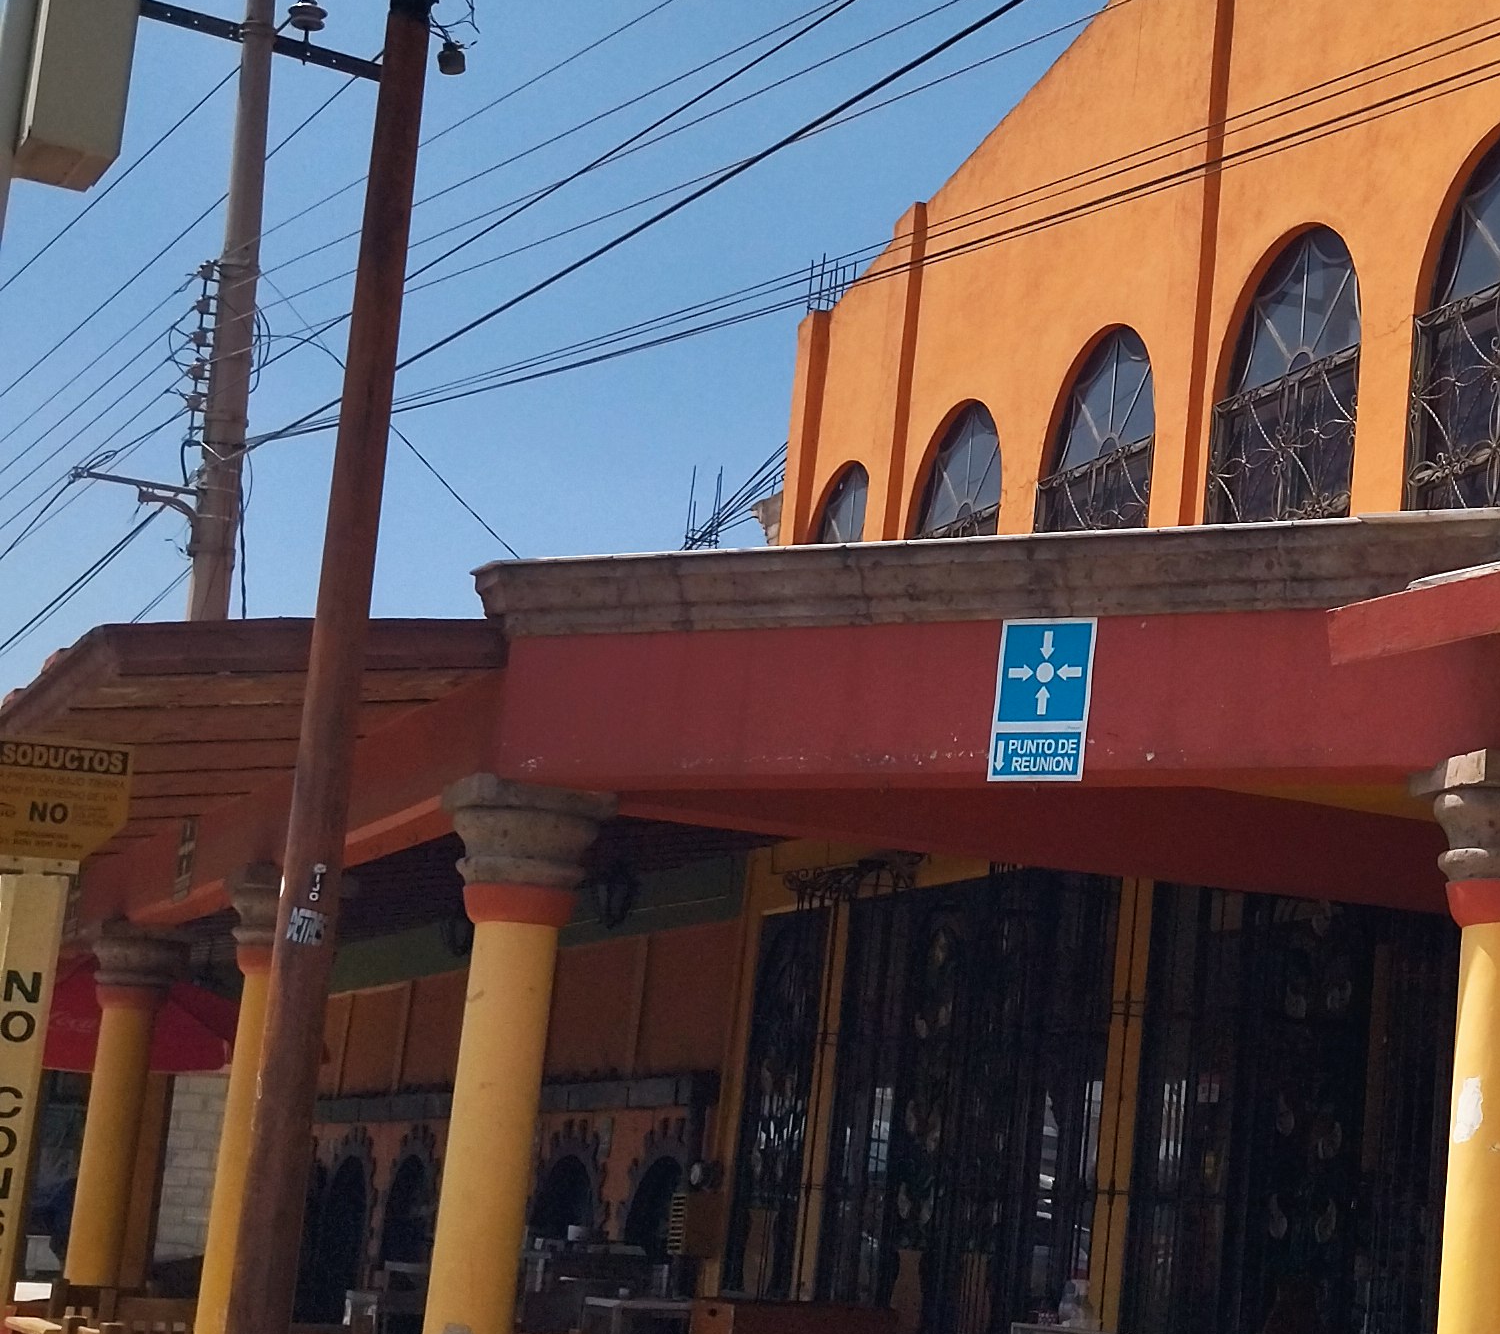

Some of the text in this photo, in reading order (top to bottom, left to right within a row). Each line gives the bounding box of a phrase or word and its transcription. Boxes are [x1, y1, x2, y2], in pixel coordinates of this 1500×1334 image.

[1008, 739, 1078, 754] PUNTO DE
[0, 743, 124, 774] SODUCTOS
[1011, 756, 1074, 772] REUNION
[29, 801, 69, 824] NO
